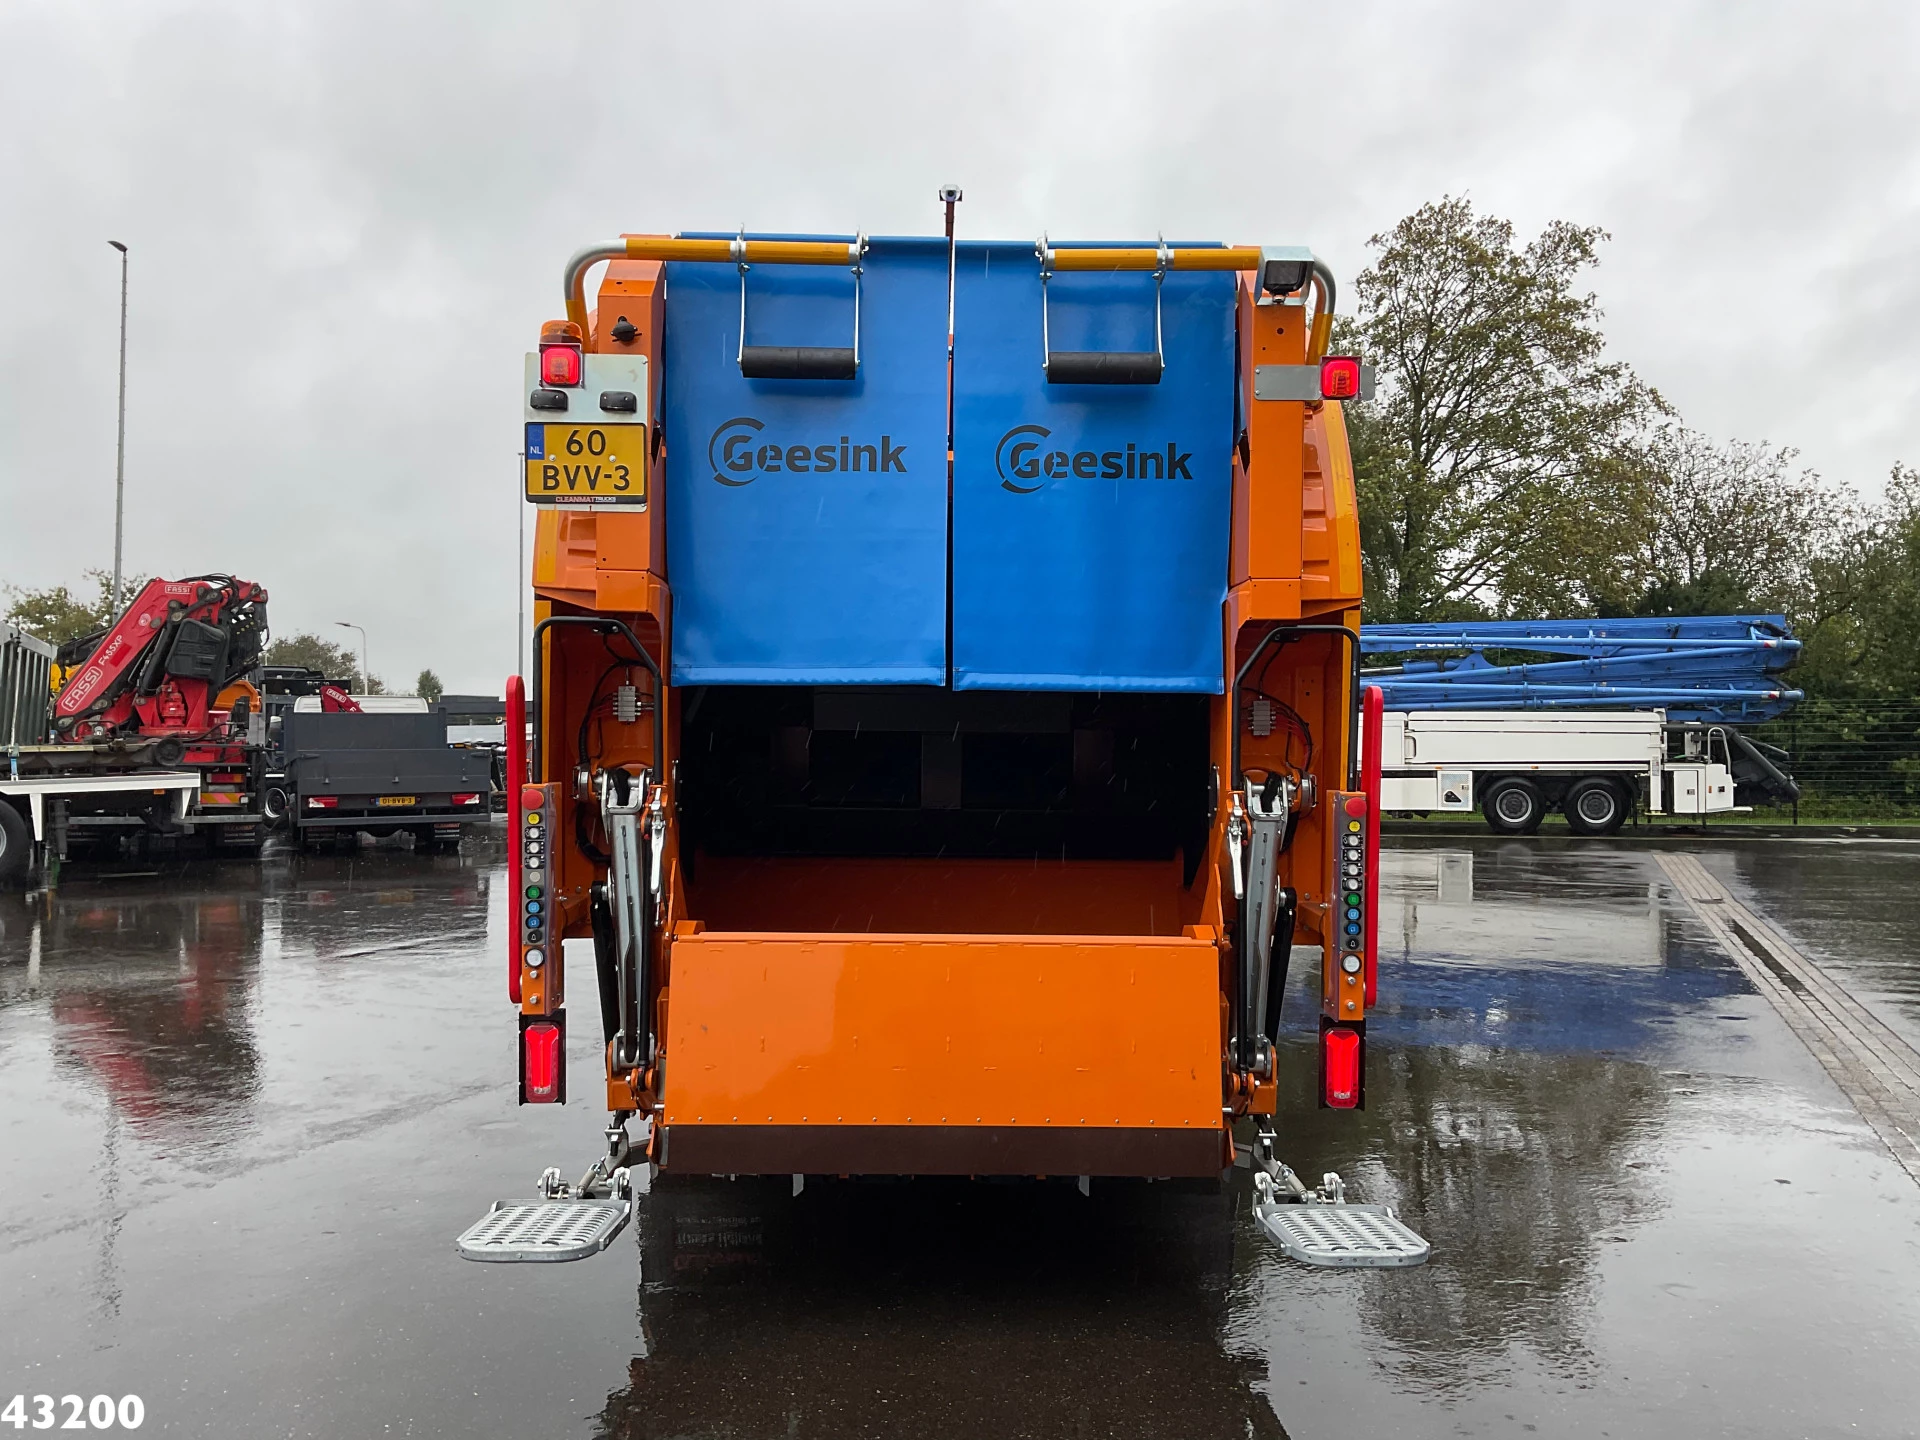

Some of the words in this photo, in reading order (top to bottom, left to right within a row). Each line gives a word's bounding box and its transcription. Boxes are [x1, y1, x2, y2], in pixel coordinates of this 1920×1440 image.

[530, 446, 543, 454] NL
[566, 429, 606, 456] 60
[723, 435, 908, 473] Geesink
[1010, 442, 1194, 480] Geesink
[542, 464, 630, 491] BVV-3
[64, 669, 101, 708] FASSI
